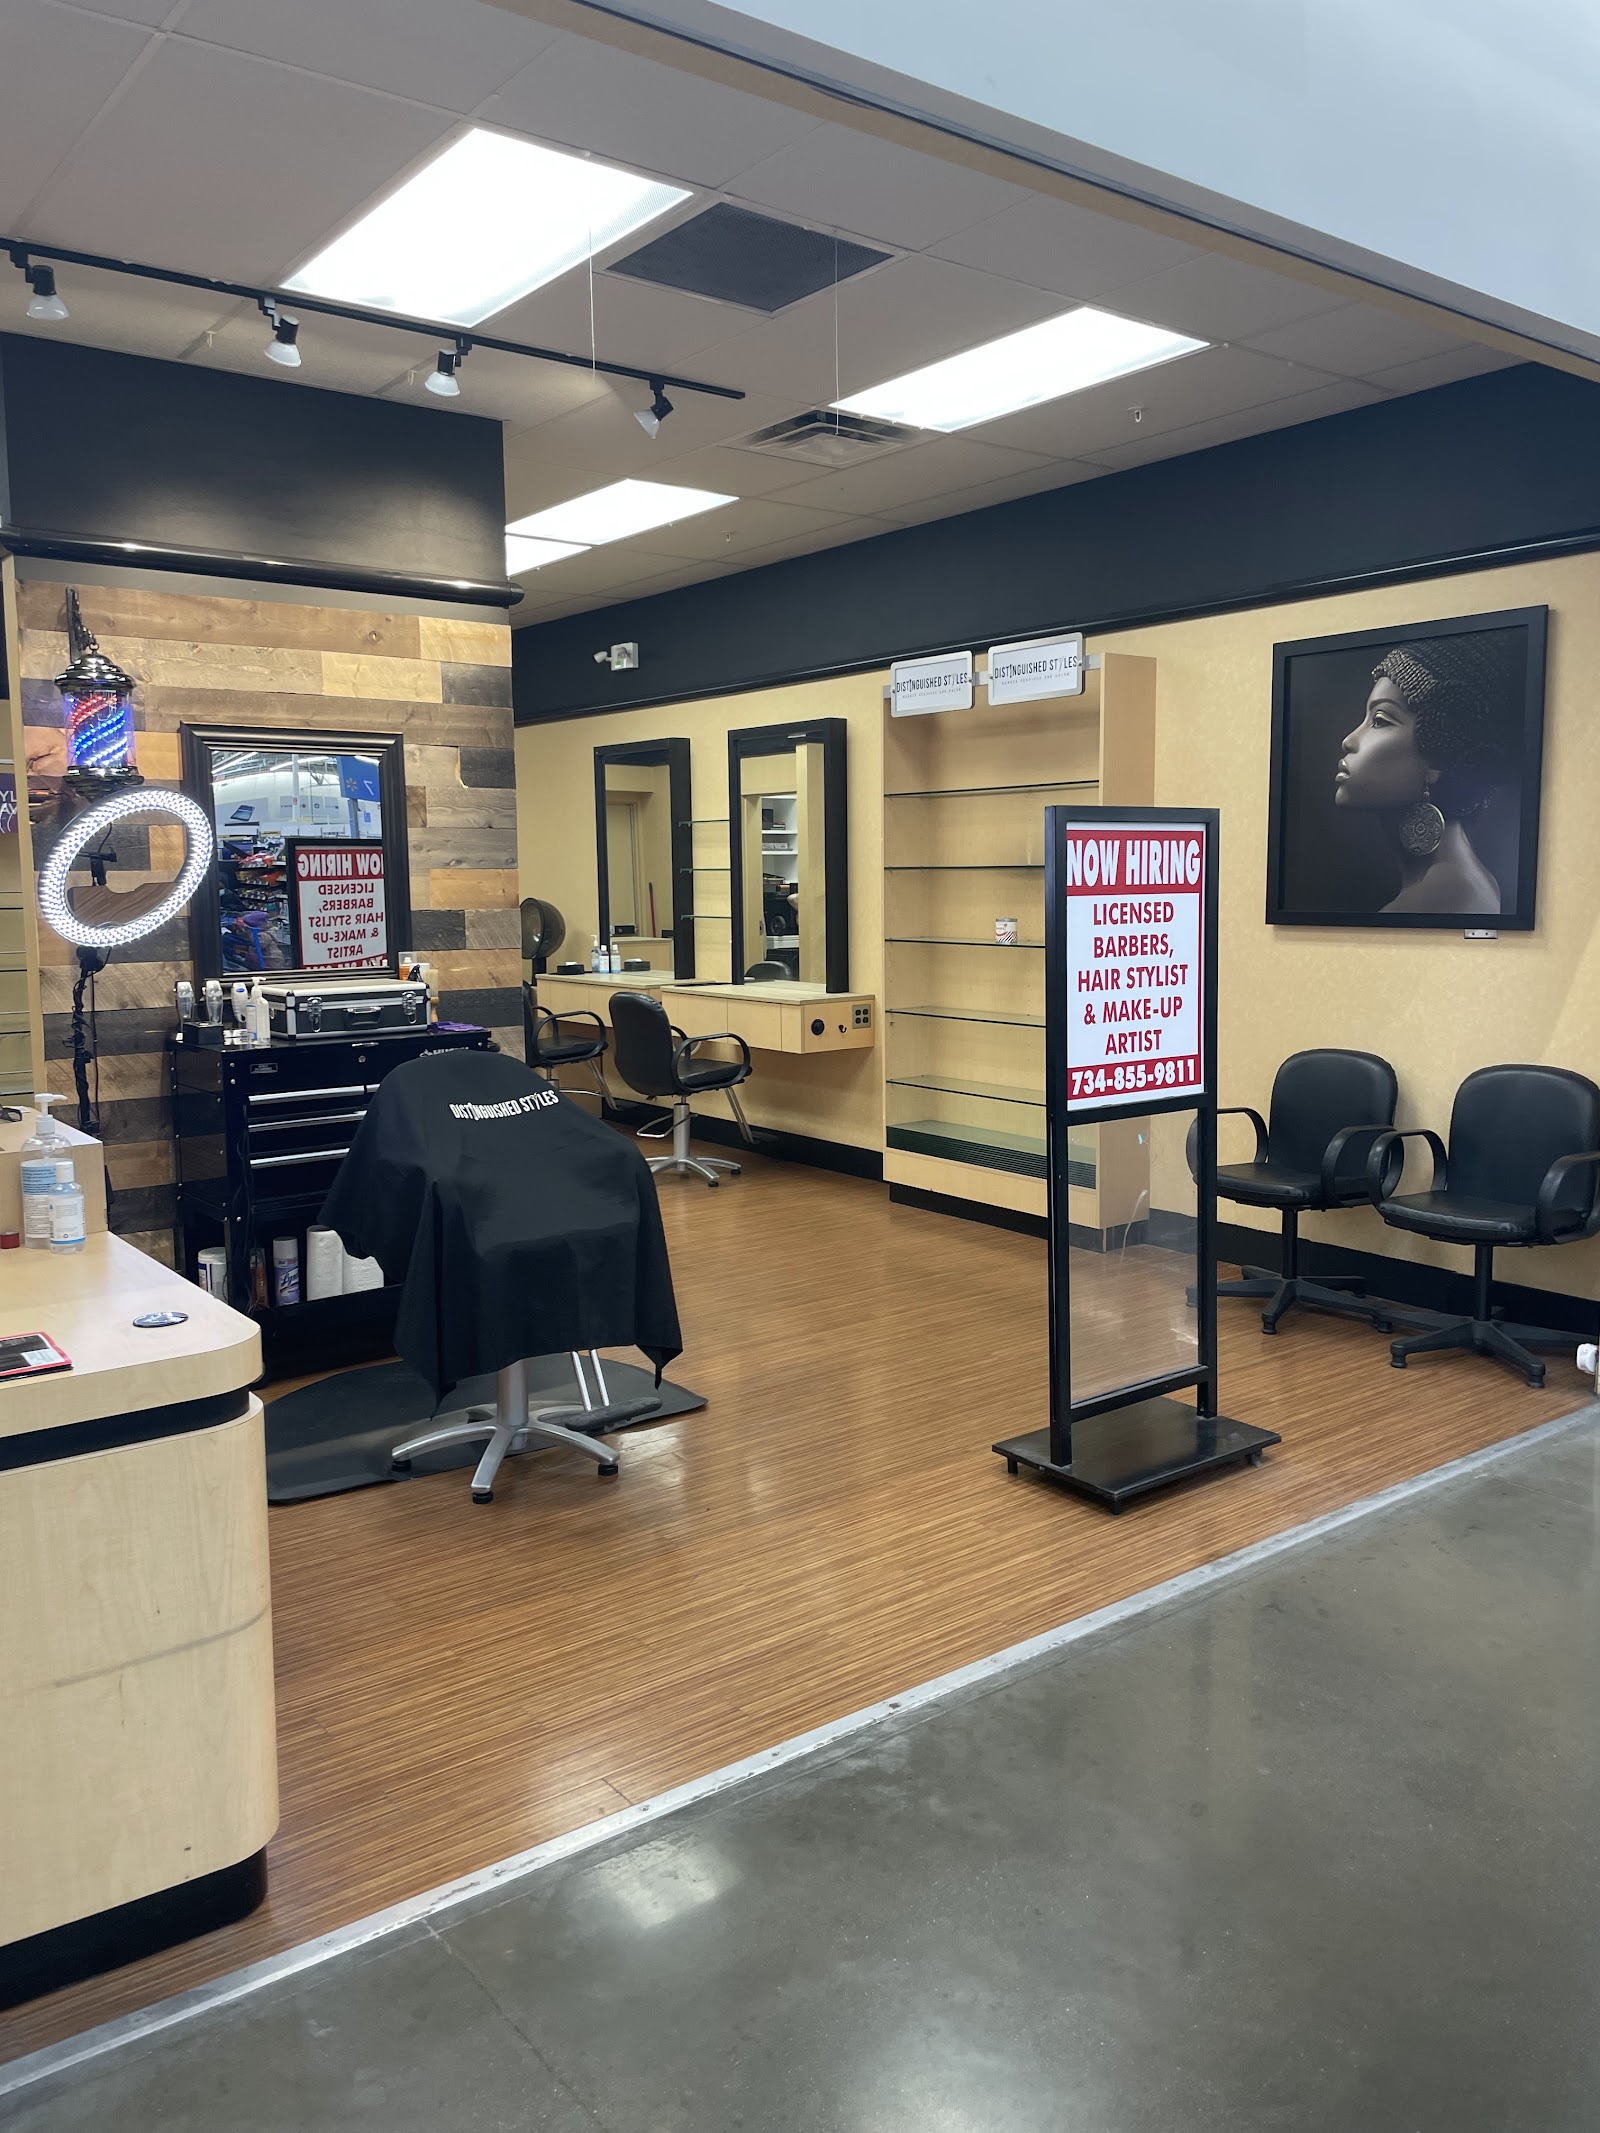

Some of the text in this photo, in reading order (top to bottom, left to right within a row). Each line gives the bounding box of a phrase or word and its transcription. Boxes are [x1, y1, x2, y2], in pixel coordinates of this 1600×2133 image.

[994, 655, 1077, 679] DISTINGUISHED STYLES
[896, 672, 968, 693] DISTINGUISHED STYLES
[1067, 839, 1200, 887] NOW HIRING
[1093, 901, 1174, 926] LICENSED
[1093, 933, 1174, 959] BARBERS,
[1078, 964, 1188, 993] HAIR STYLIST
[1083, 996, 1183, 1025] & MAKE-UP
[1105, 1029, 1162, 1056] ARTIST
[1072, 1058, 1195, 1096] 734-855-9811
[449, 1089, 559, 1121] DISTINGUISHED STYLES
